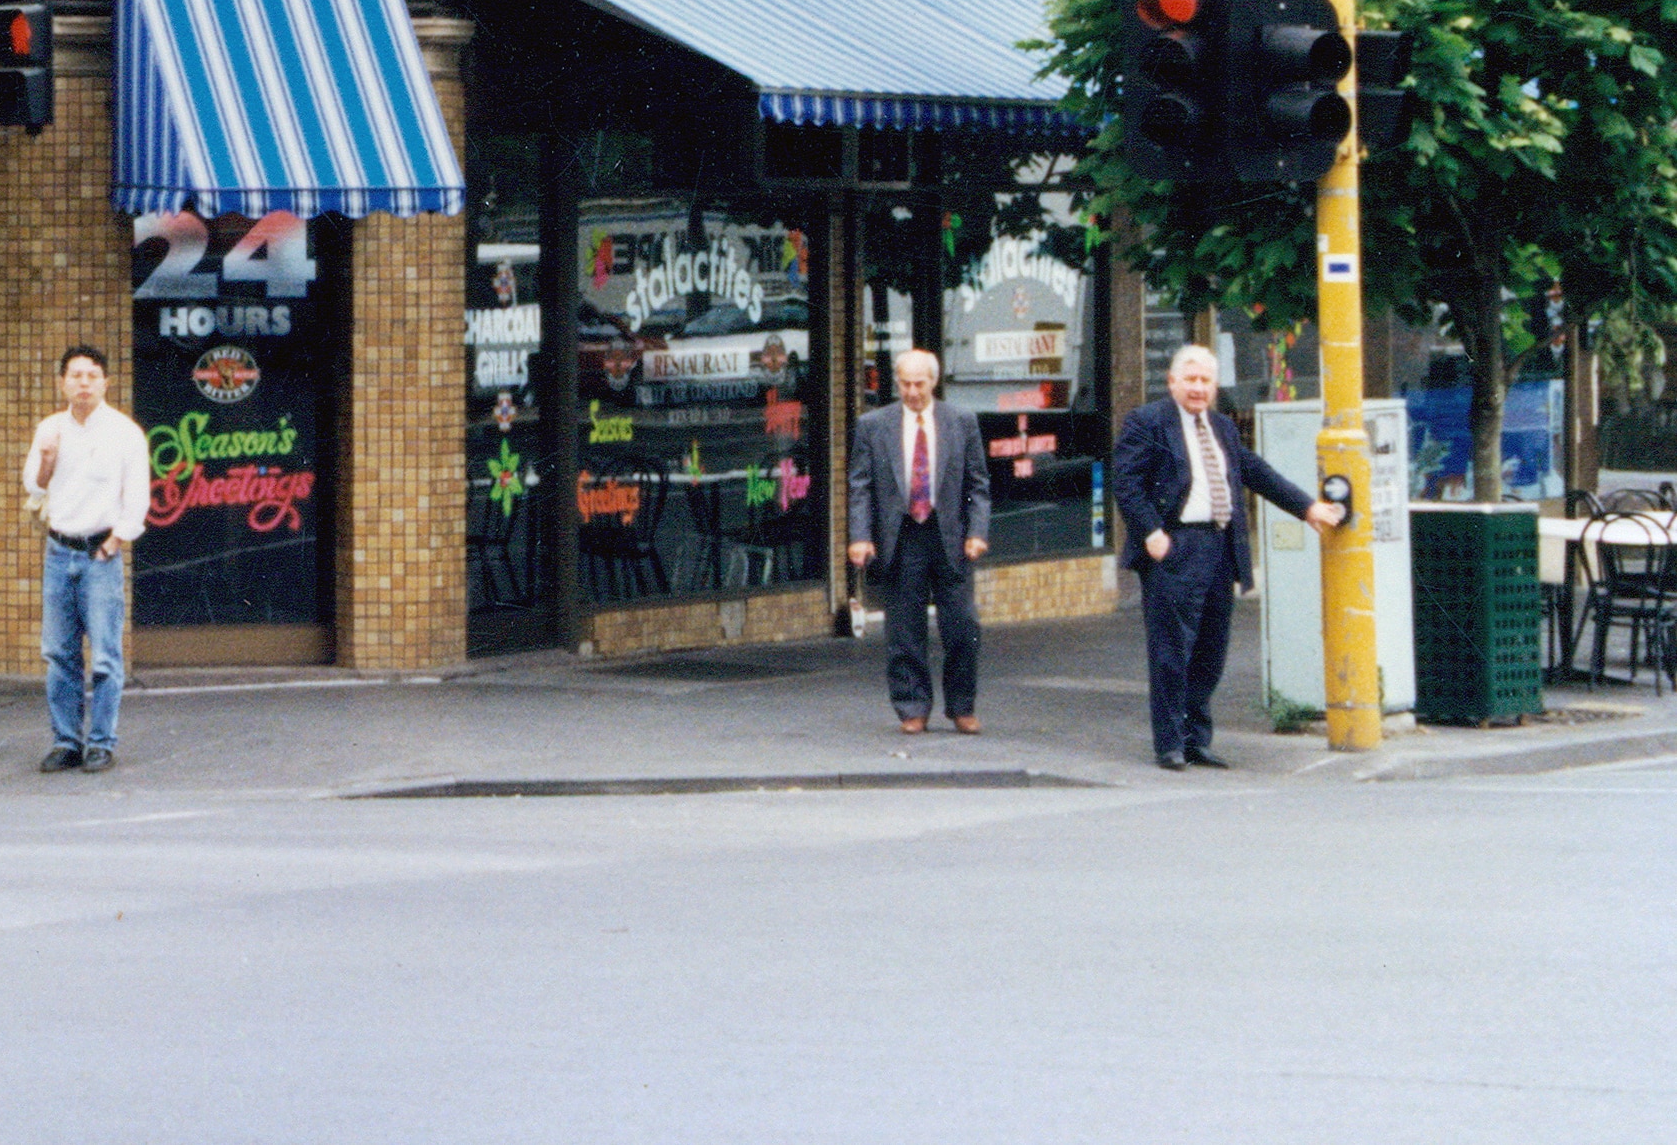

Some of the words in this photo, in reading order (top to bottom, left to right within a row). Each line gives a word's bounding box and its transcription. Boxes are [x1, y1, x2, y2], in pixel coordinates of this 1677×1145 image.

[133, 210, 317, 299] 24
[626, 235, 764, 333] stalactites
[159, 307, 292, 337] HOURS
[654, 352, 741, 378] RESTAURANT
